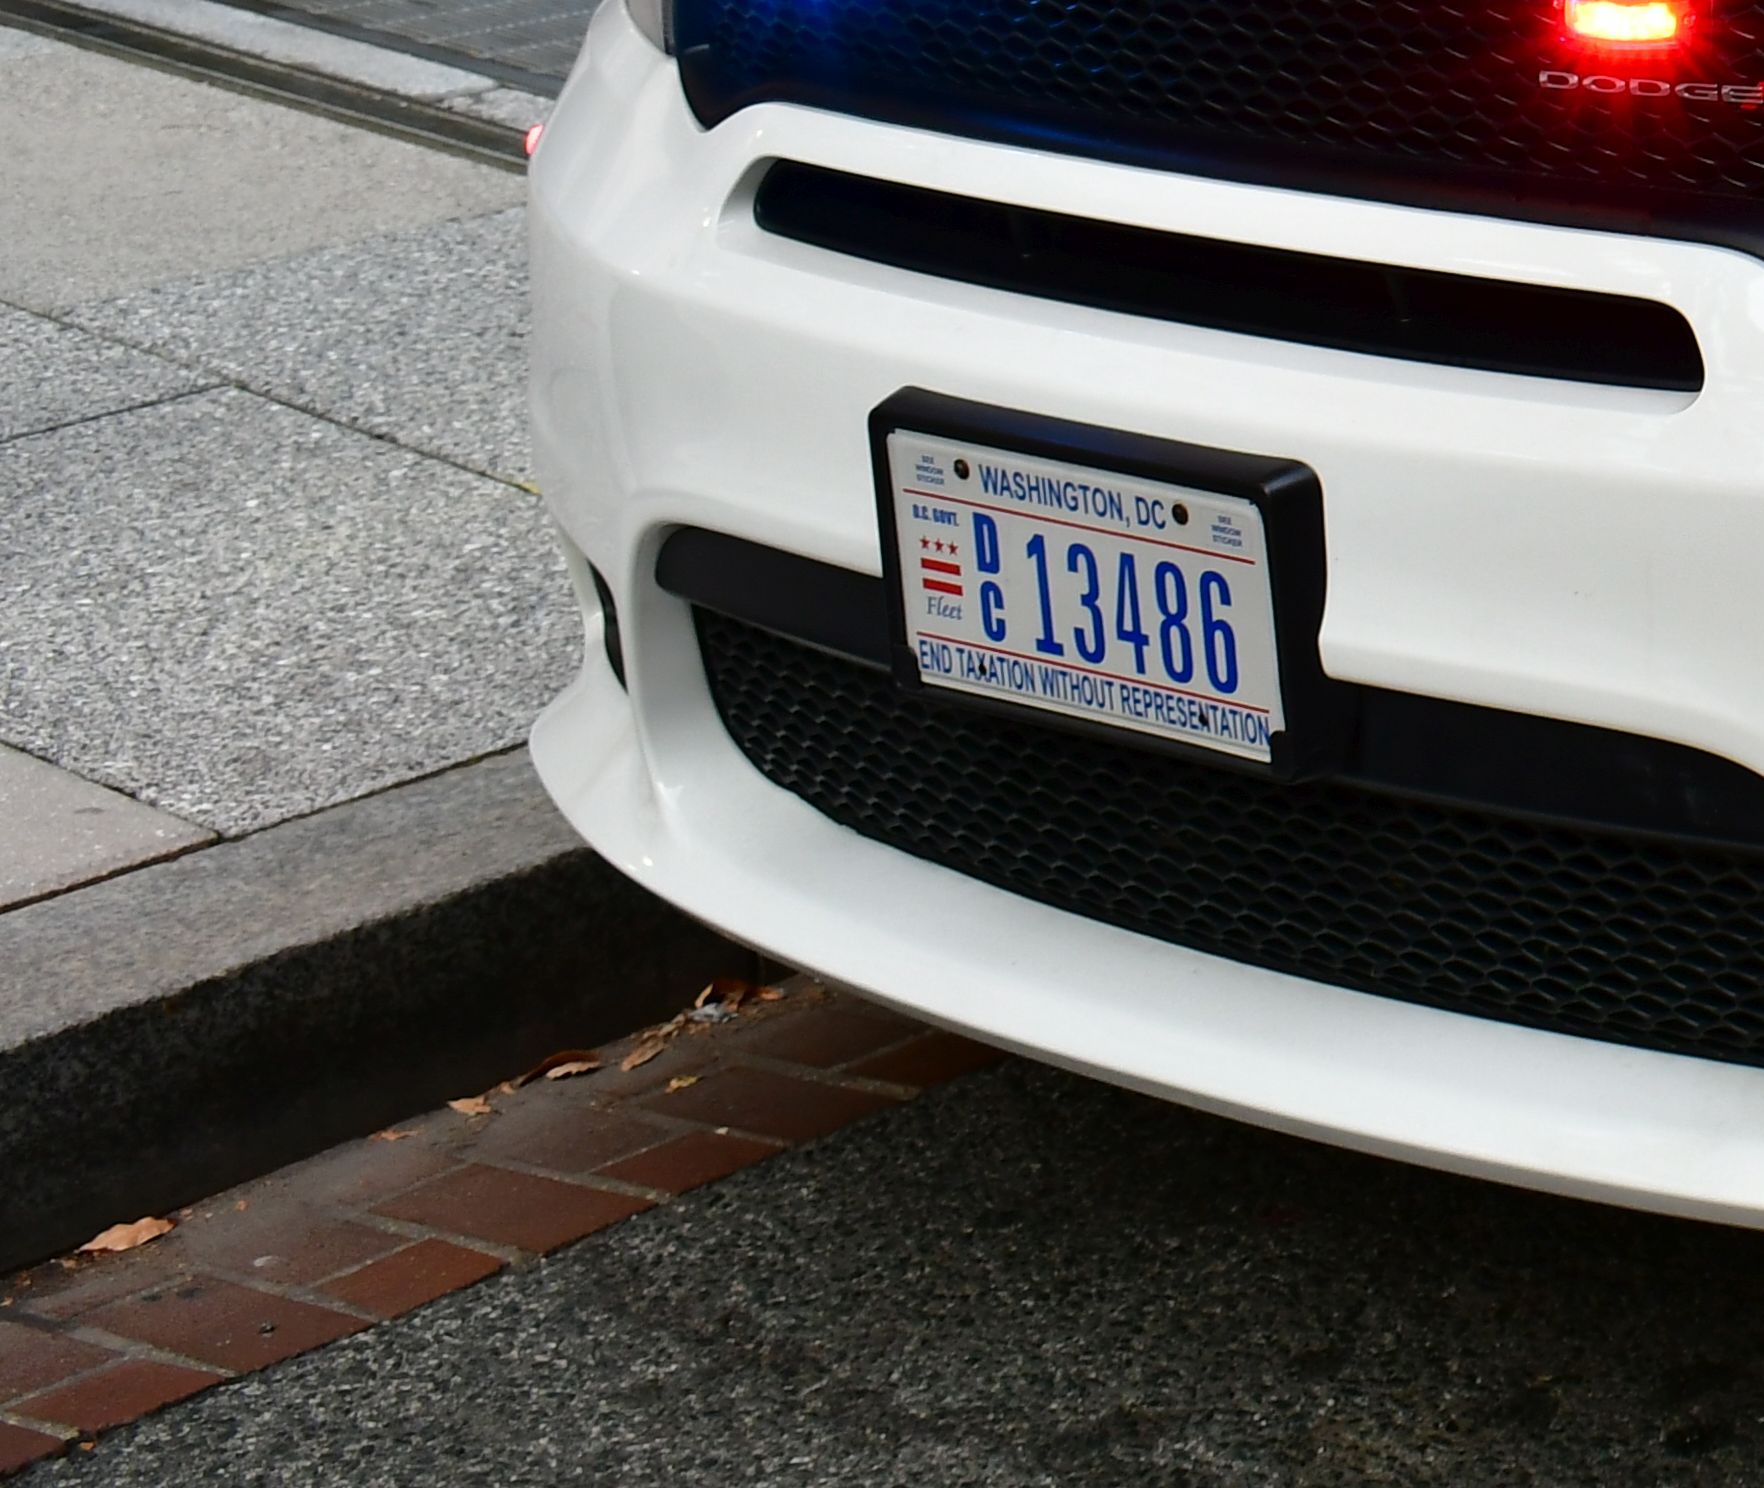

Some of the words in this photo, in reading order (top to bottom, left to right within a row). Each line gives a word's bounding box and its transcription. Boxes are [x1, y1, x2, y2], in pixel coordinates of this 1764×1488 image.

[1539, 70, 1764, 104] DODGE
[979, 464, 1131, 527] WASHINGTON,
[1134, 496, 1167, 529] DC
[927, 596, 963, 620] Fleet
[1026, 533, 1239, 694] 13486
[918, 640, 953, 673] END
[956, 647, 1035, 693] TAXATION
[1039, 664, 1115, 709] WITHOUT
[1121, 682, 1271, 747] REPRESENTATION
